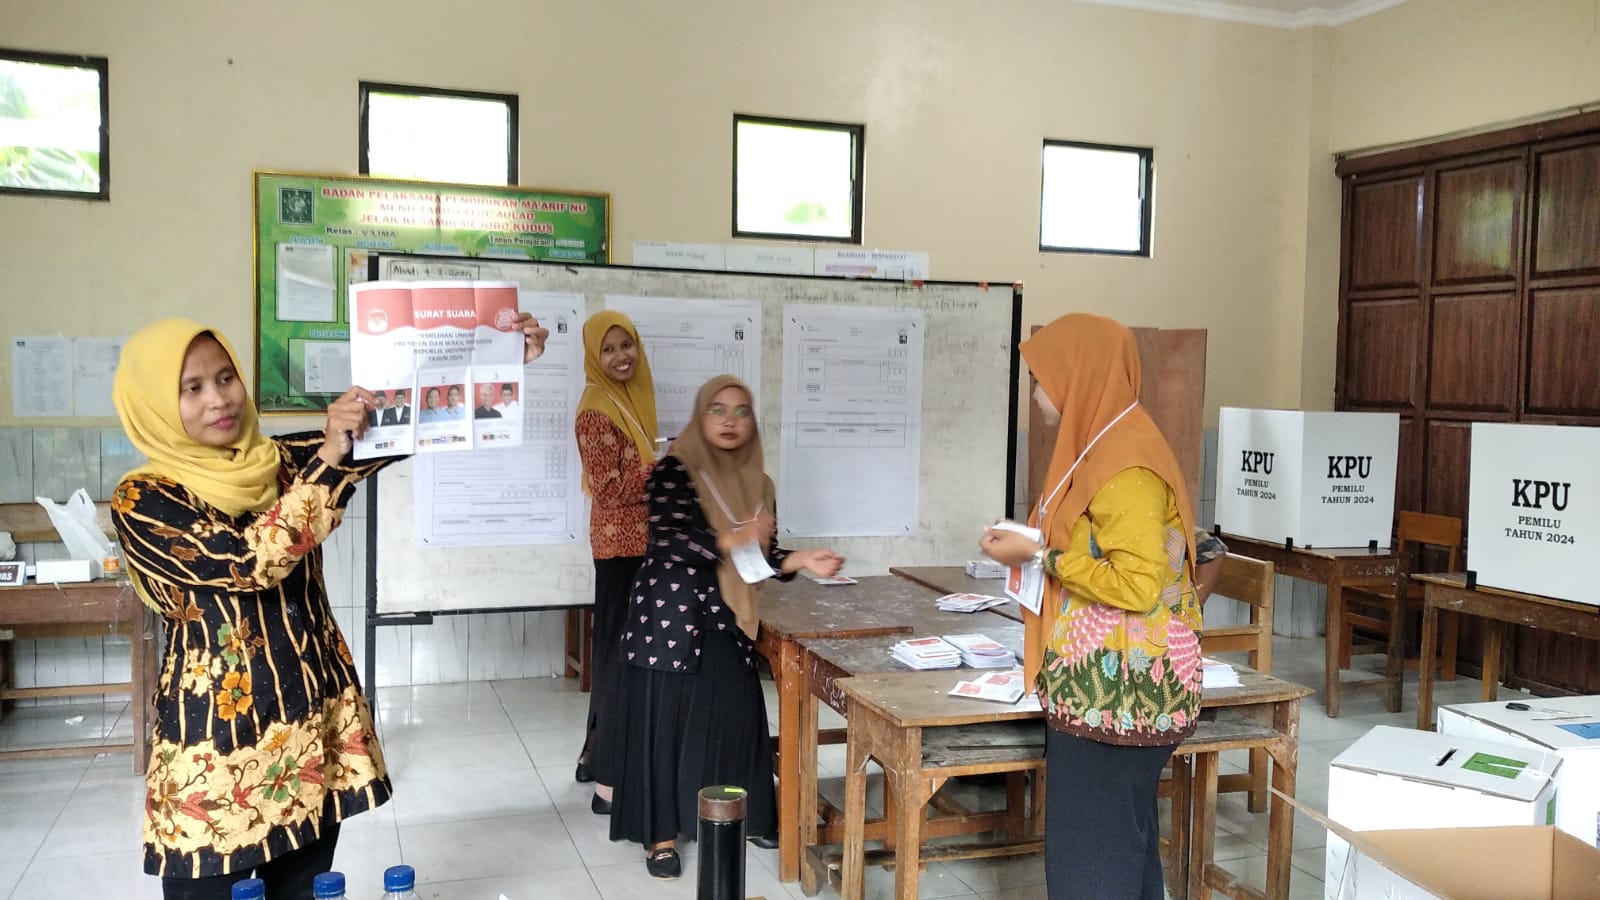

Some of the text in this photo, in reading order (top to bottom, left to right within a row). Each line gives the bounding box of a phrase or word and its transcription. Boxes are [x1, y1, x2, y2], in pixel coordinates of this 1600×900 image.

[322, 187, 587, 213] BADAN PELAKSANA PENDIDIKAN MA'ARIF NU
[496, 210, 536, 221] AULAD
[326, 226, 353, 235] Kelas
[513, 223, 554, 234] KUDUS
[489, 235, 513, 244] Tahun
[514, 236, 551, 247] Pelajaran
[414, 308, 477, 319] SURAT SUARA
[1241, 450, 1275, 475] KPU
[1327, 456, 1373, 479] KPU
[1244, 478, 1269, 488] PEMILU
[1332, 485, 1365, 493] PEMILU
[1236, 488, 1277, 500] TAHUN 2024
[1321, 496, 1375, 504] TAHUN 2024
[1512, 478, 1571, 511] KPU
[1518, 516, 1562, 529] PEMILU
[1504, 528, 1575, 545] TAHUN 2024
